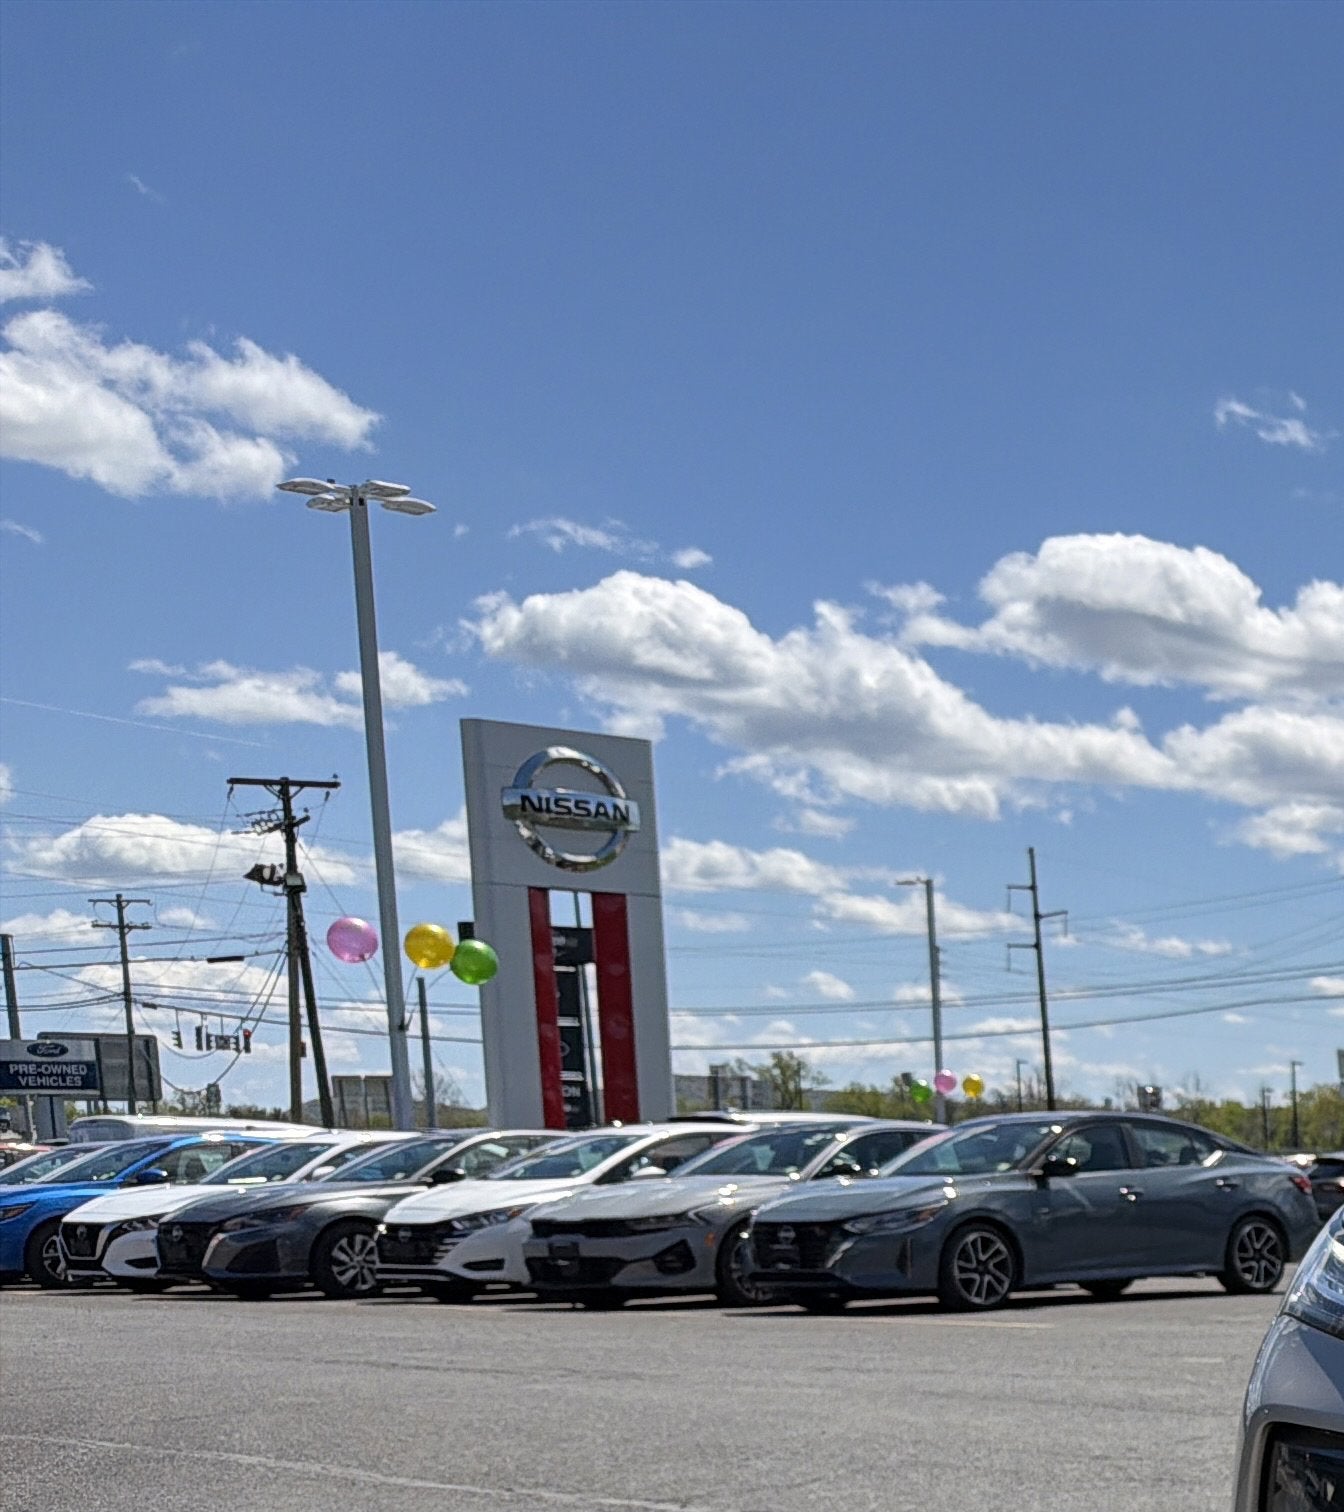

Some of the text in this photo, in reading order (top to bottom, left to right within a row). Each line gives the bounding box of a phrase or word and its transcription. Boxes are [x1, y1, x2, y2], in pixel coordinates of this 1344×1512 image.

[520, 794, 630, 823] NISSAN
[36, 1044, 60, 1054] Ford
[9, 1063, 88, 1075] PRE-OWNED
[18, 1075, 82, 1087] VEHICLES
